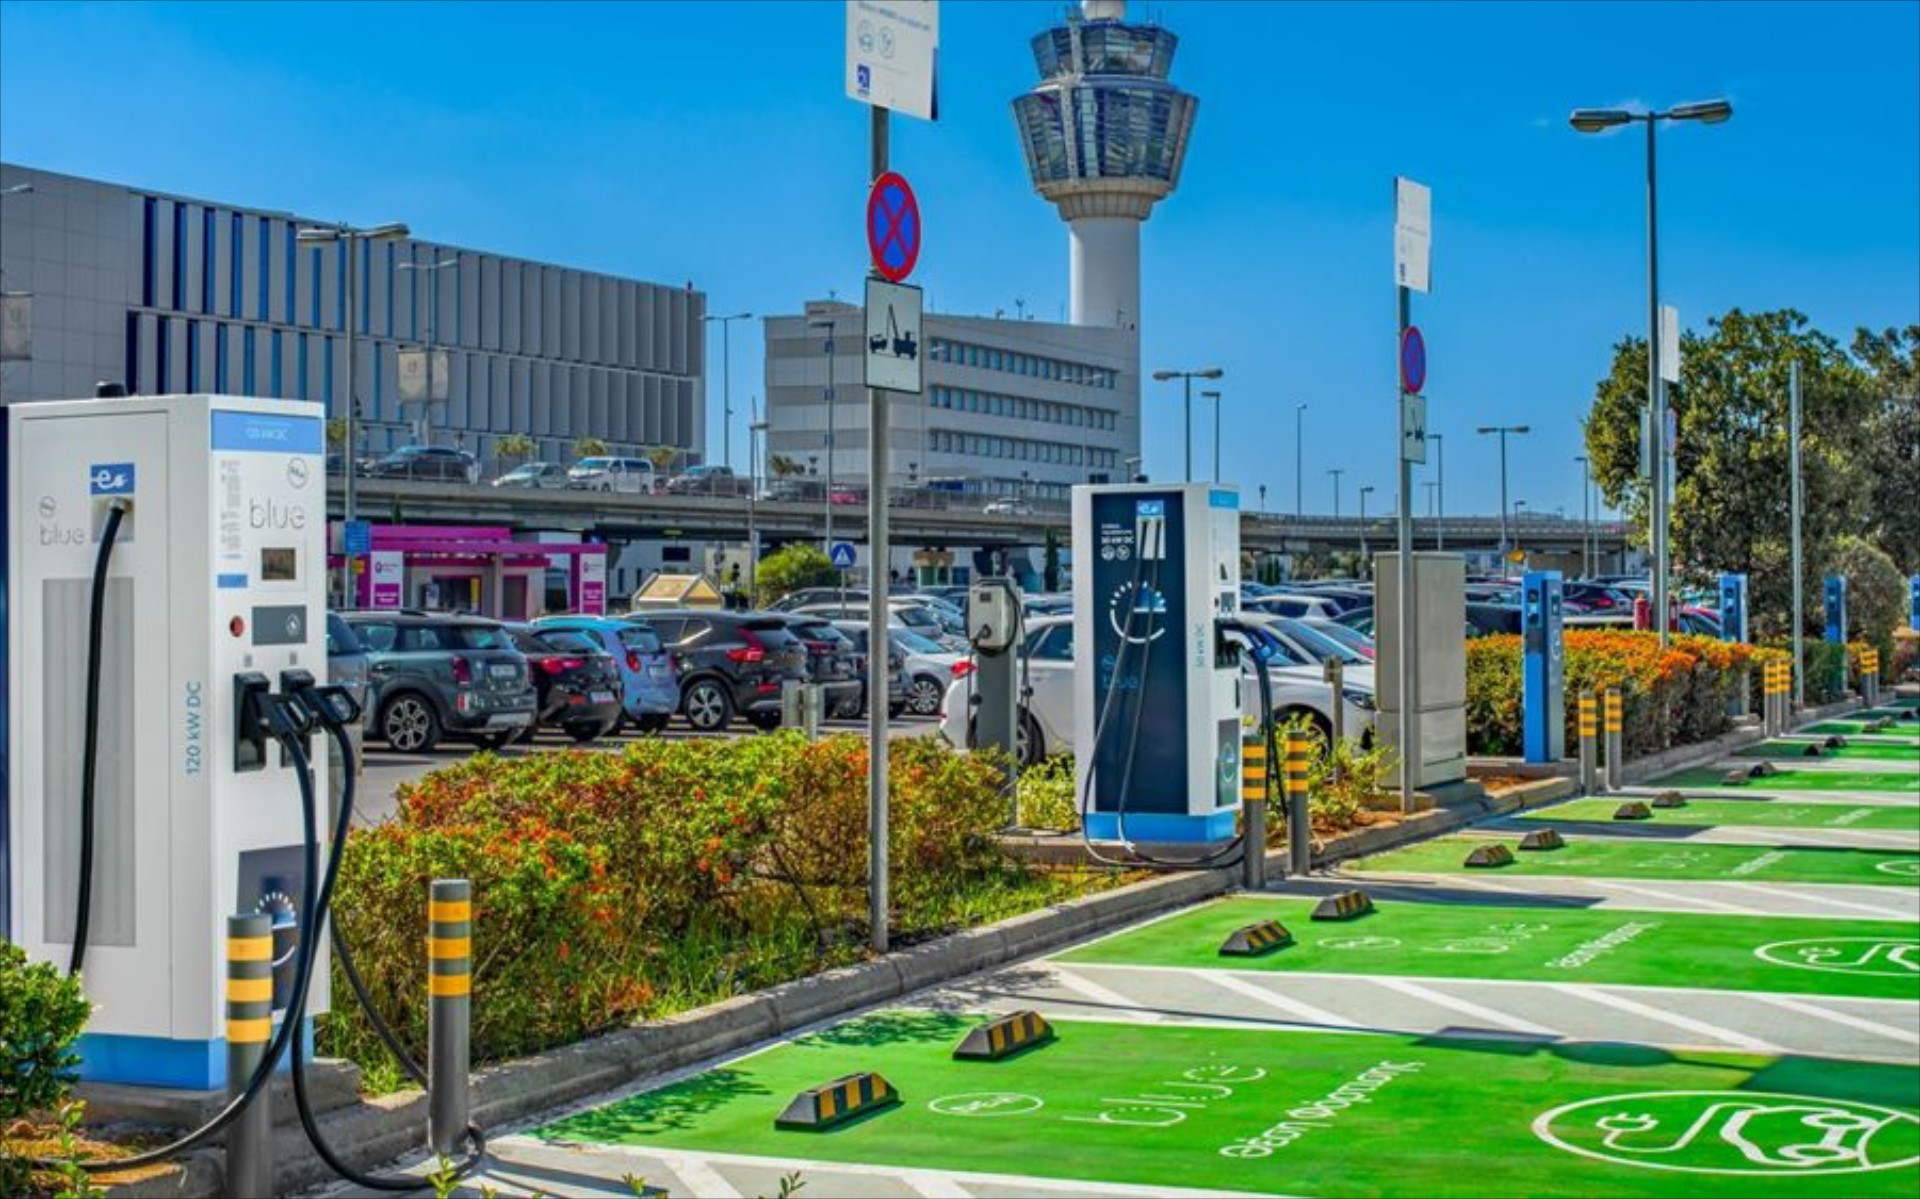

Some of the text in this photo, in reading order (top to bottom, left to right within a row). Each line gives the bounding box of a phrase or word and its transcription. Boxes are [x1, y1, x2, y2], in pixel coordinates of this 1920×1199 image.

[249, 497, 306, 529] blue
[40, 523, 84, 546] blue
[185, 680, 201, 776] 120 kW DC
